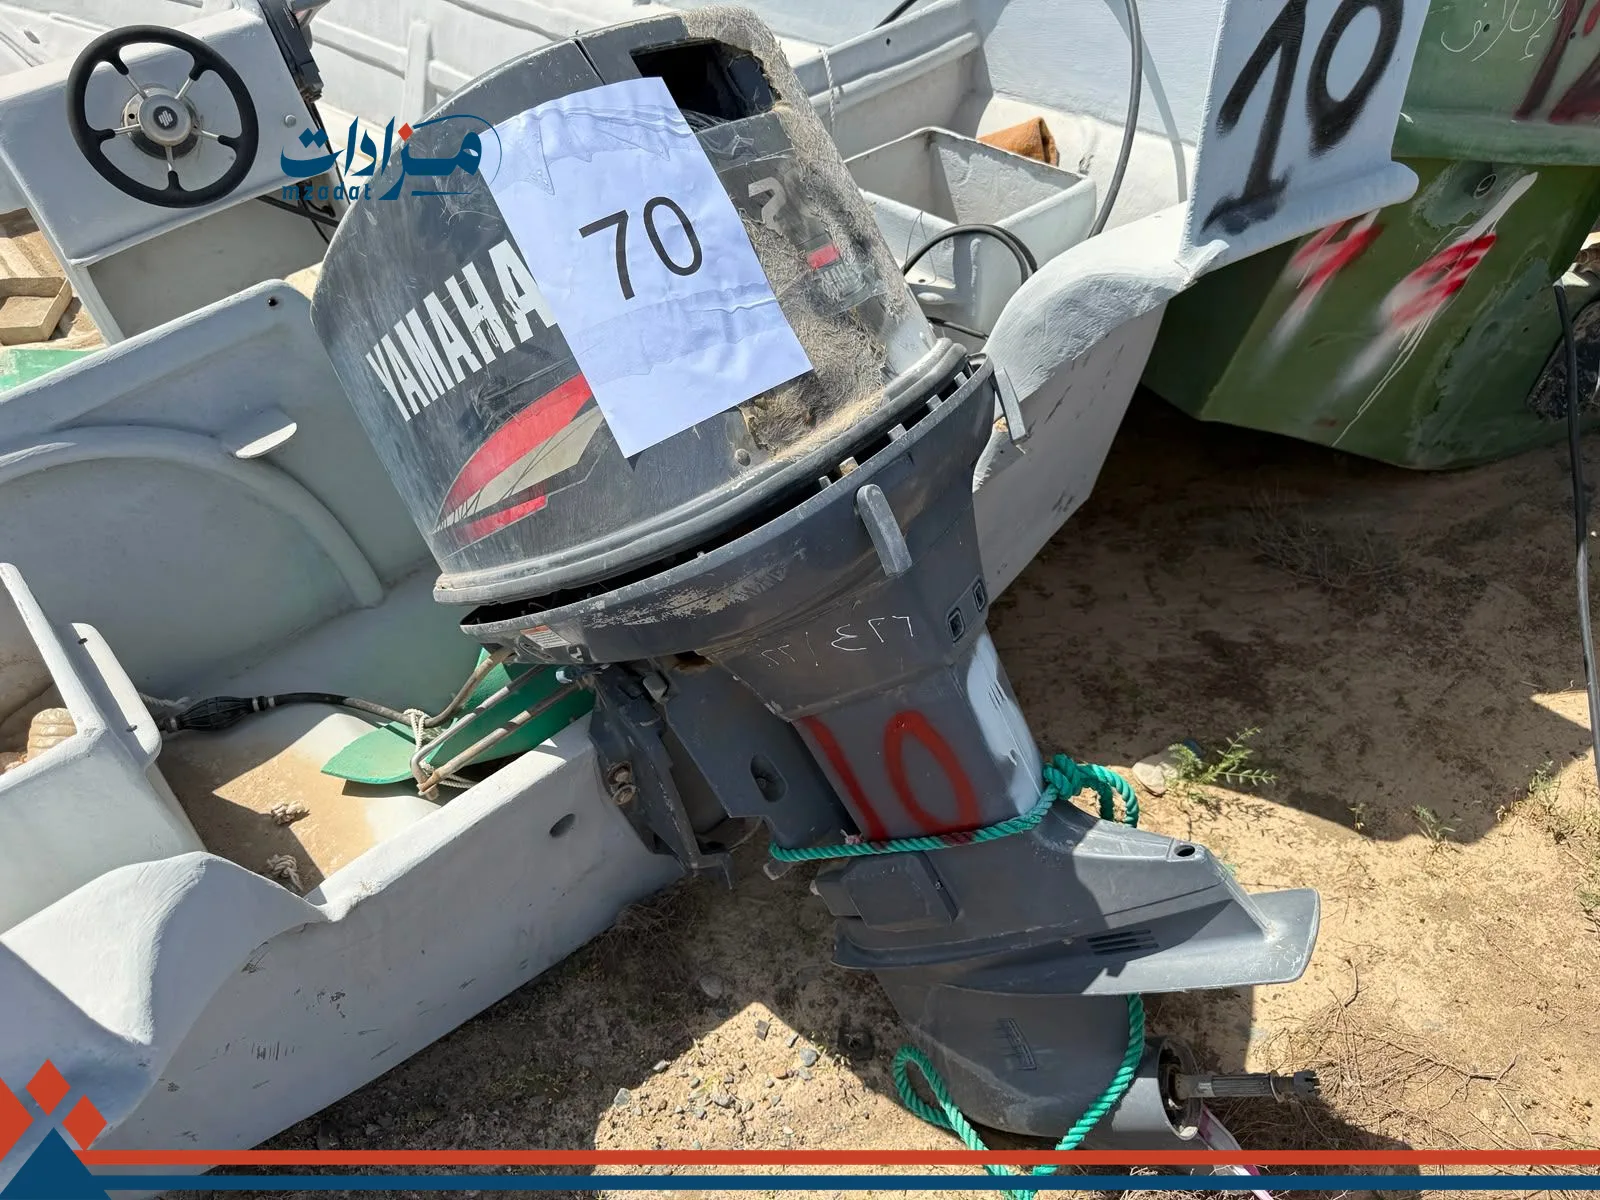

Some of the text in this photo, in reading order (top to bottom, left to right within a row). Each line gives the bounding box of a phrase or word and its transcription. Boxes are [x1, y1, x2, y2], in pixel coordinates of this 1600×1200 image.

[1201, 0, 1405, 235] 10
[364, 239, 557, 422] YAMAHA
[578, 195, 703, 301] 70
